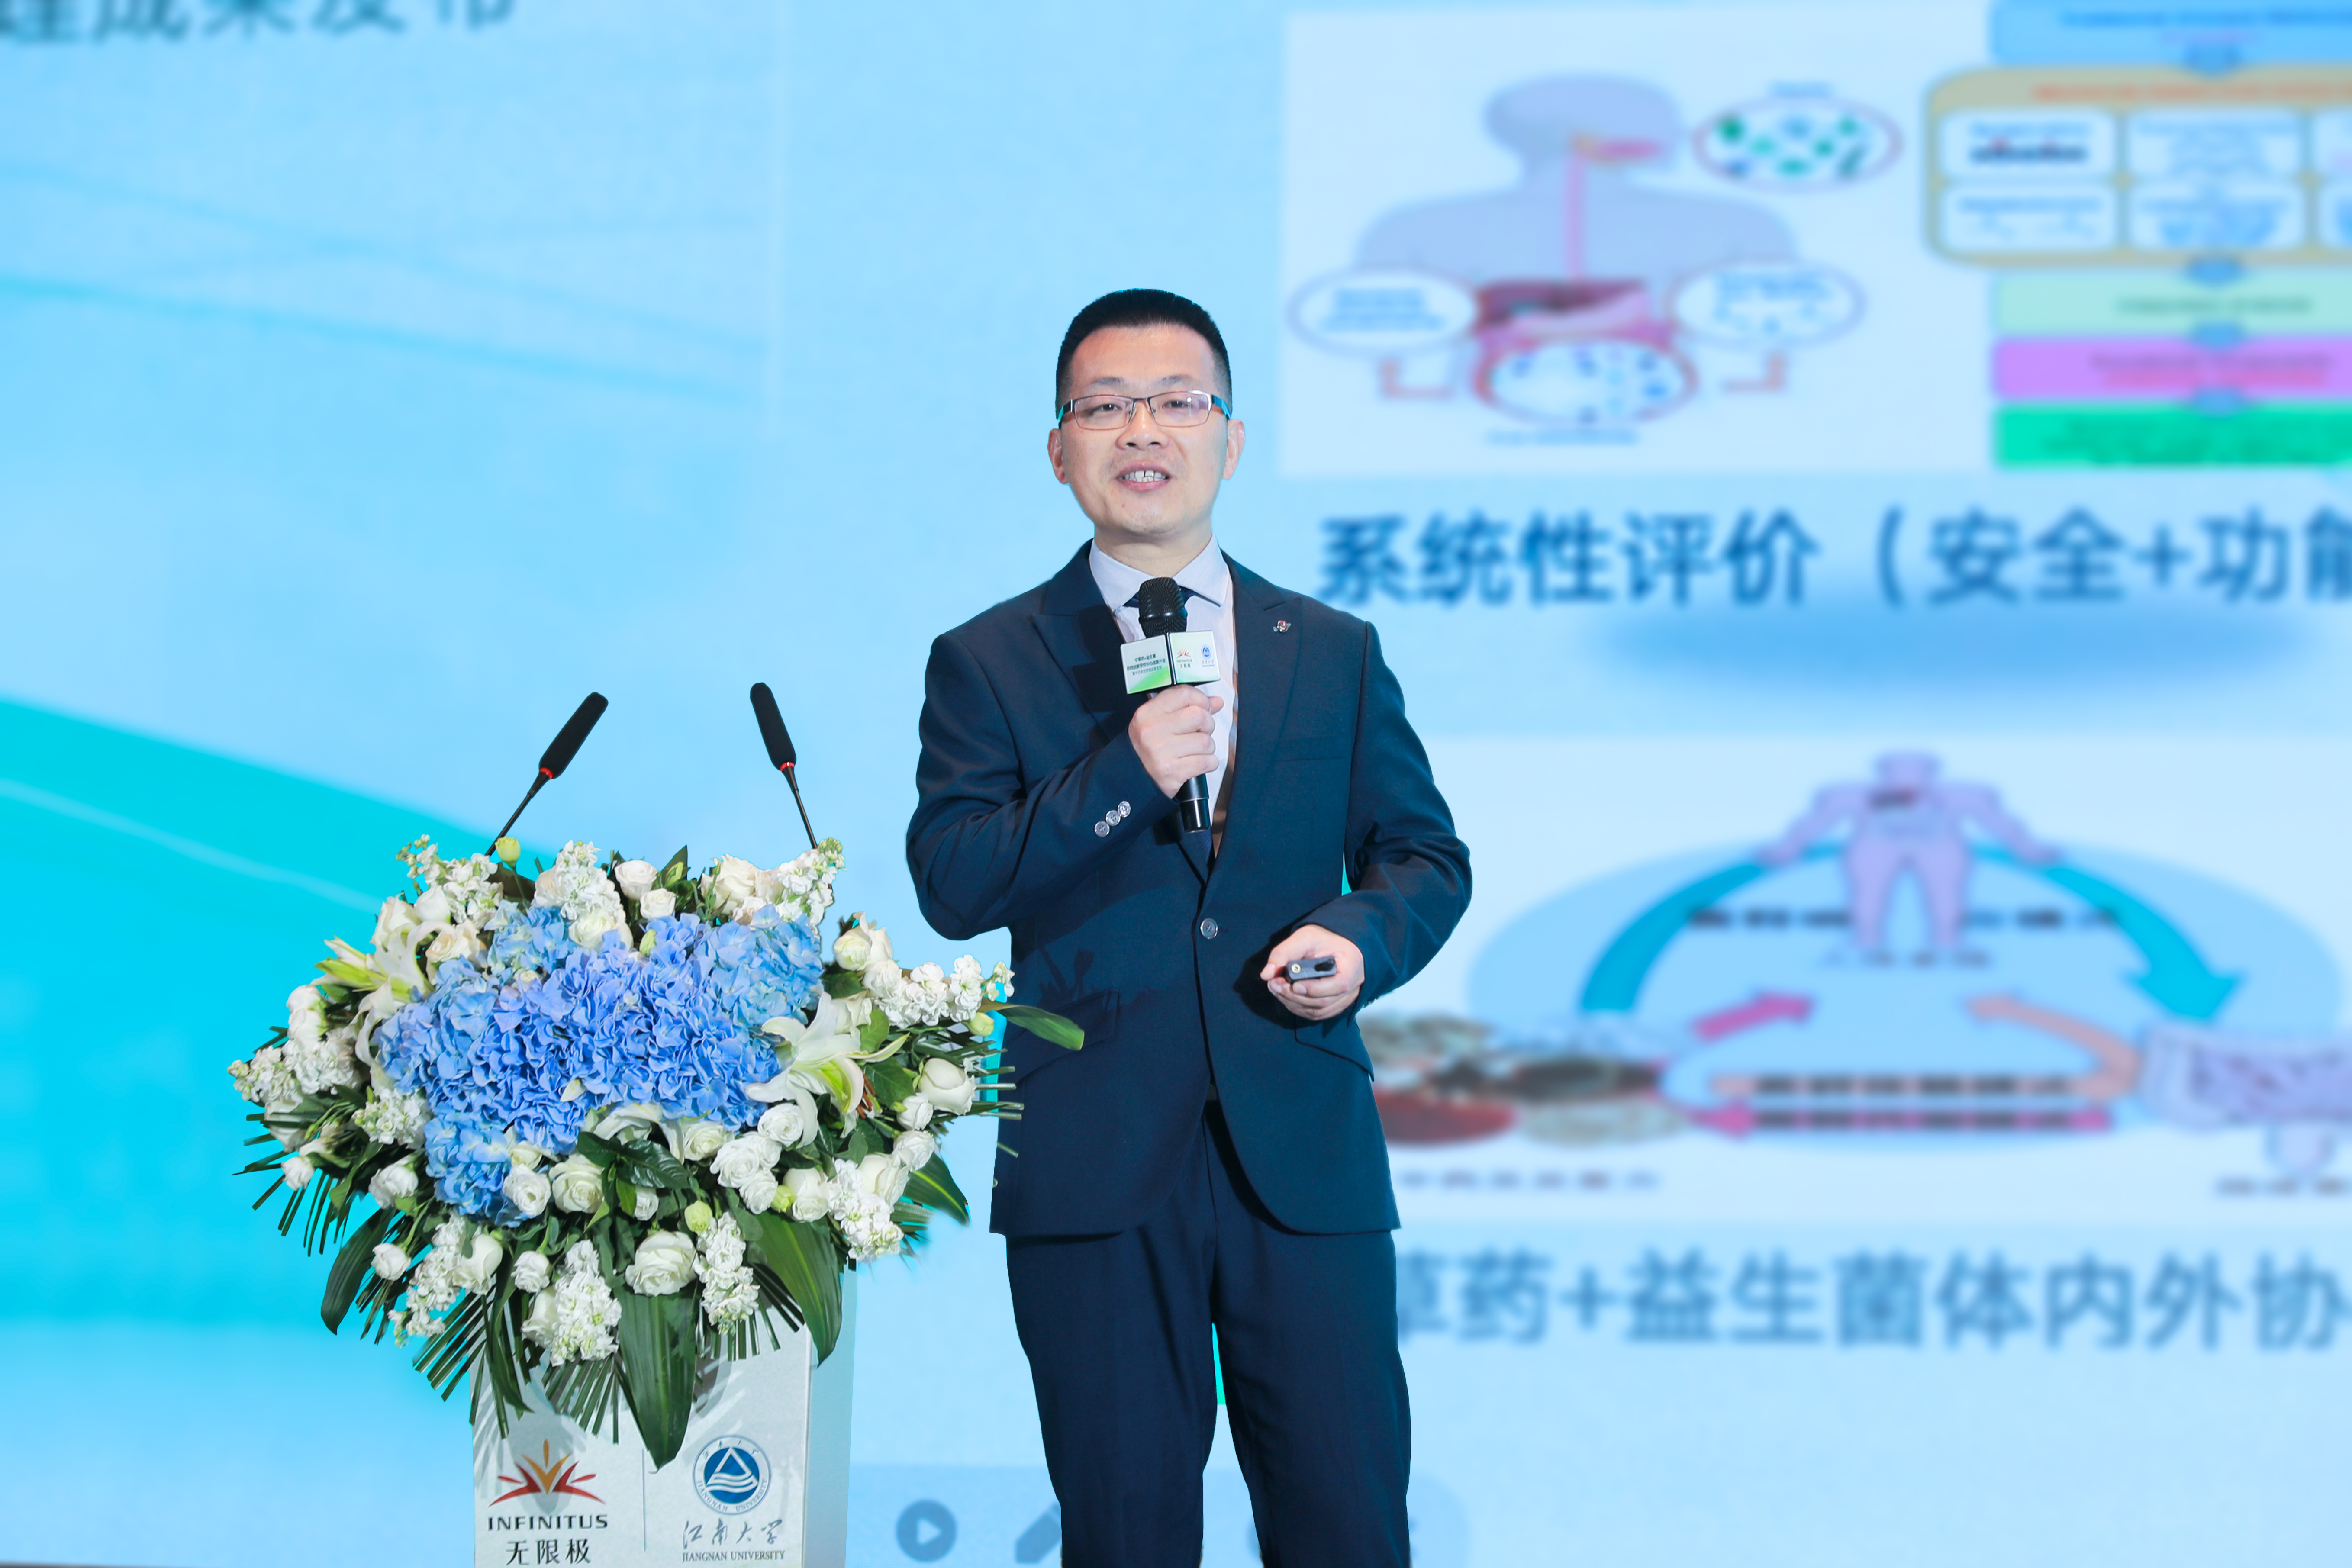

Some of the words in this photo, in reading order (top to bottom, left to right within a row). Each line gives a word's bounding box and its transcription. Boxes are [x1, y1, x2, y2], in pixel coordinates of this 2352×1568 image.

[488, 1514, 608, 1531] INFINITUS
[683, 1518, 783, 1550] 江南大学
[506, 1538, 591, 1566] 无限极
[682, 1552, 727, 1564] JIANGNAN
[730, 1550, 786, 1561] UNIVERSITY
